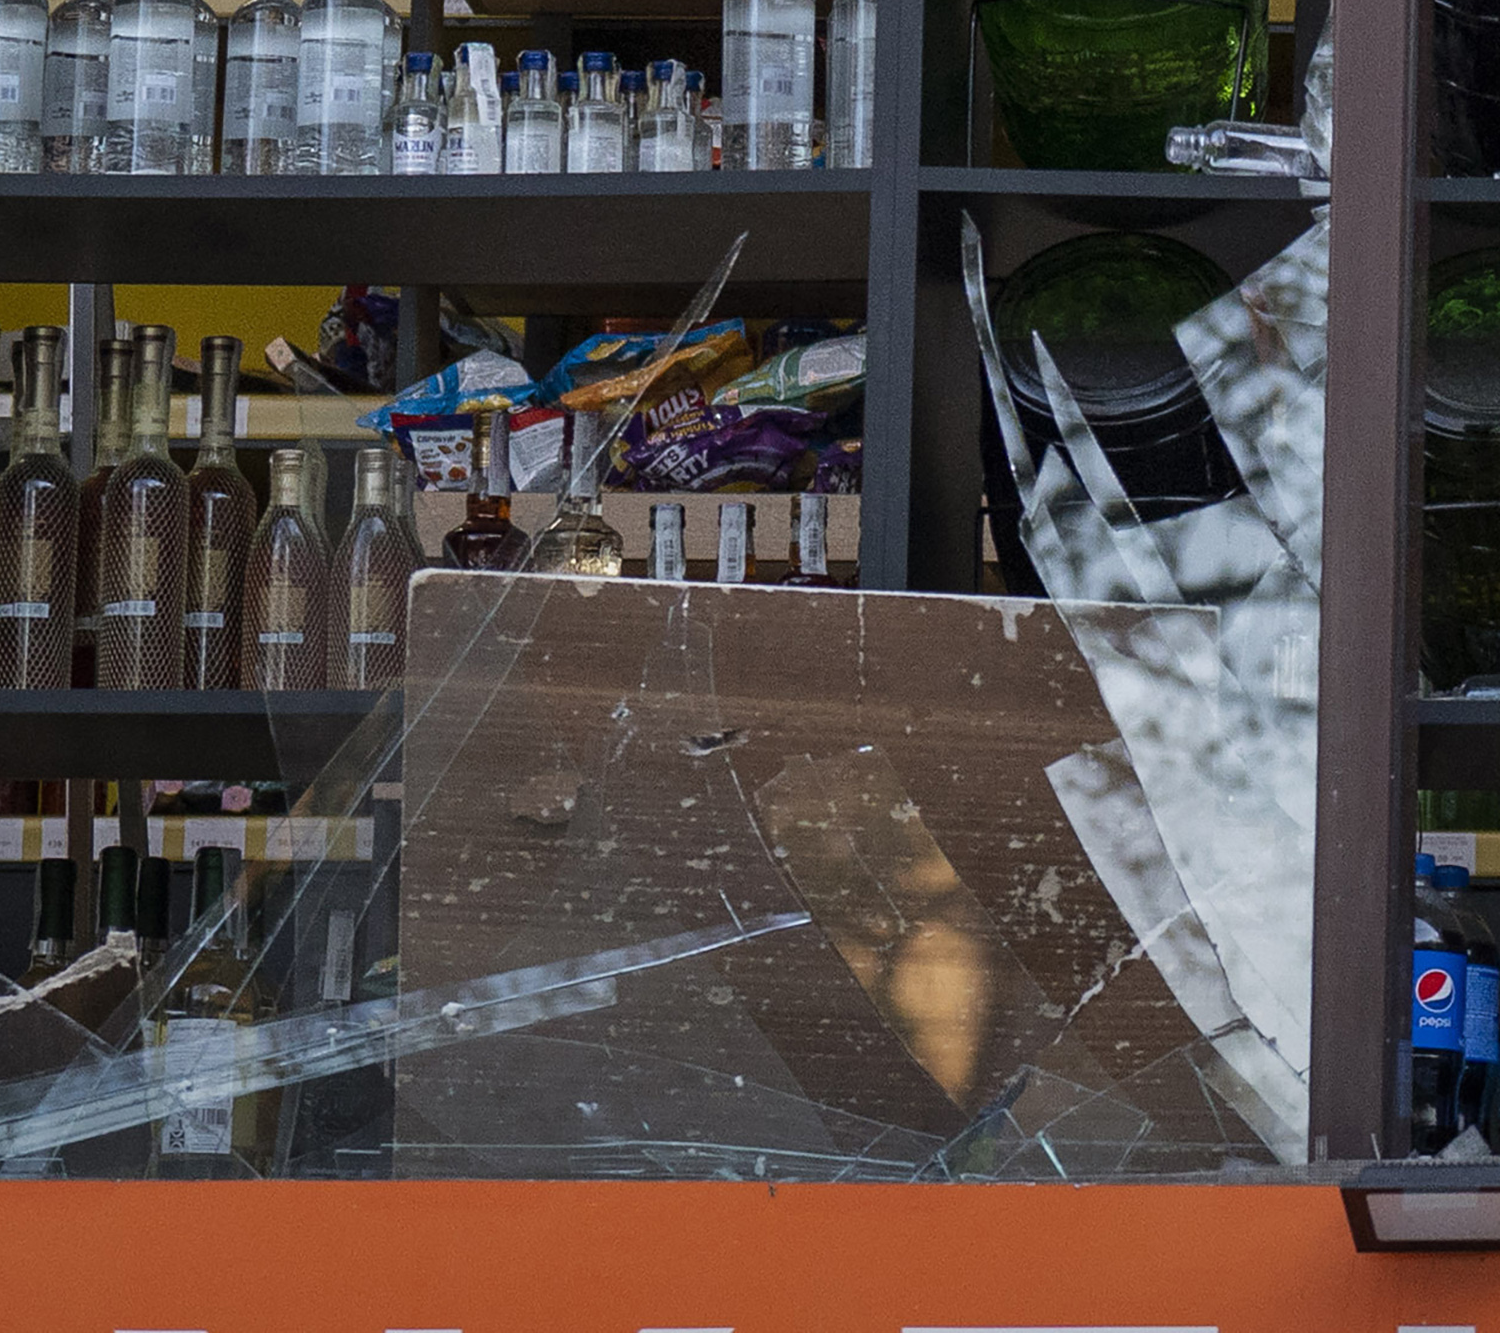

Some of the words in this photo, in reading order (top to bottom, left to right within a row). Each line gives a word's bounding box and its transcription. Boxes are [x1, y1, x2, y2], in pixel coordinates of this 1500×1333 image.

[395, 140, 435, 154] MARLIN
[668, 448, 709, 484] RTY
[1418, 1016, 1451, 1029] pepsi
